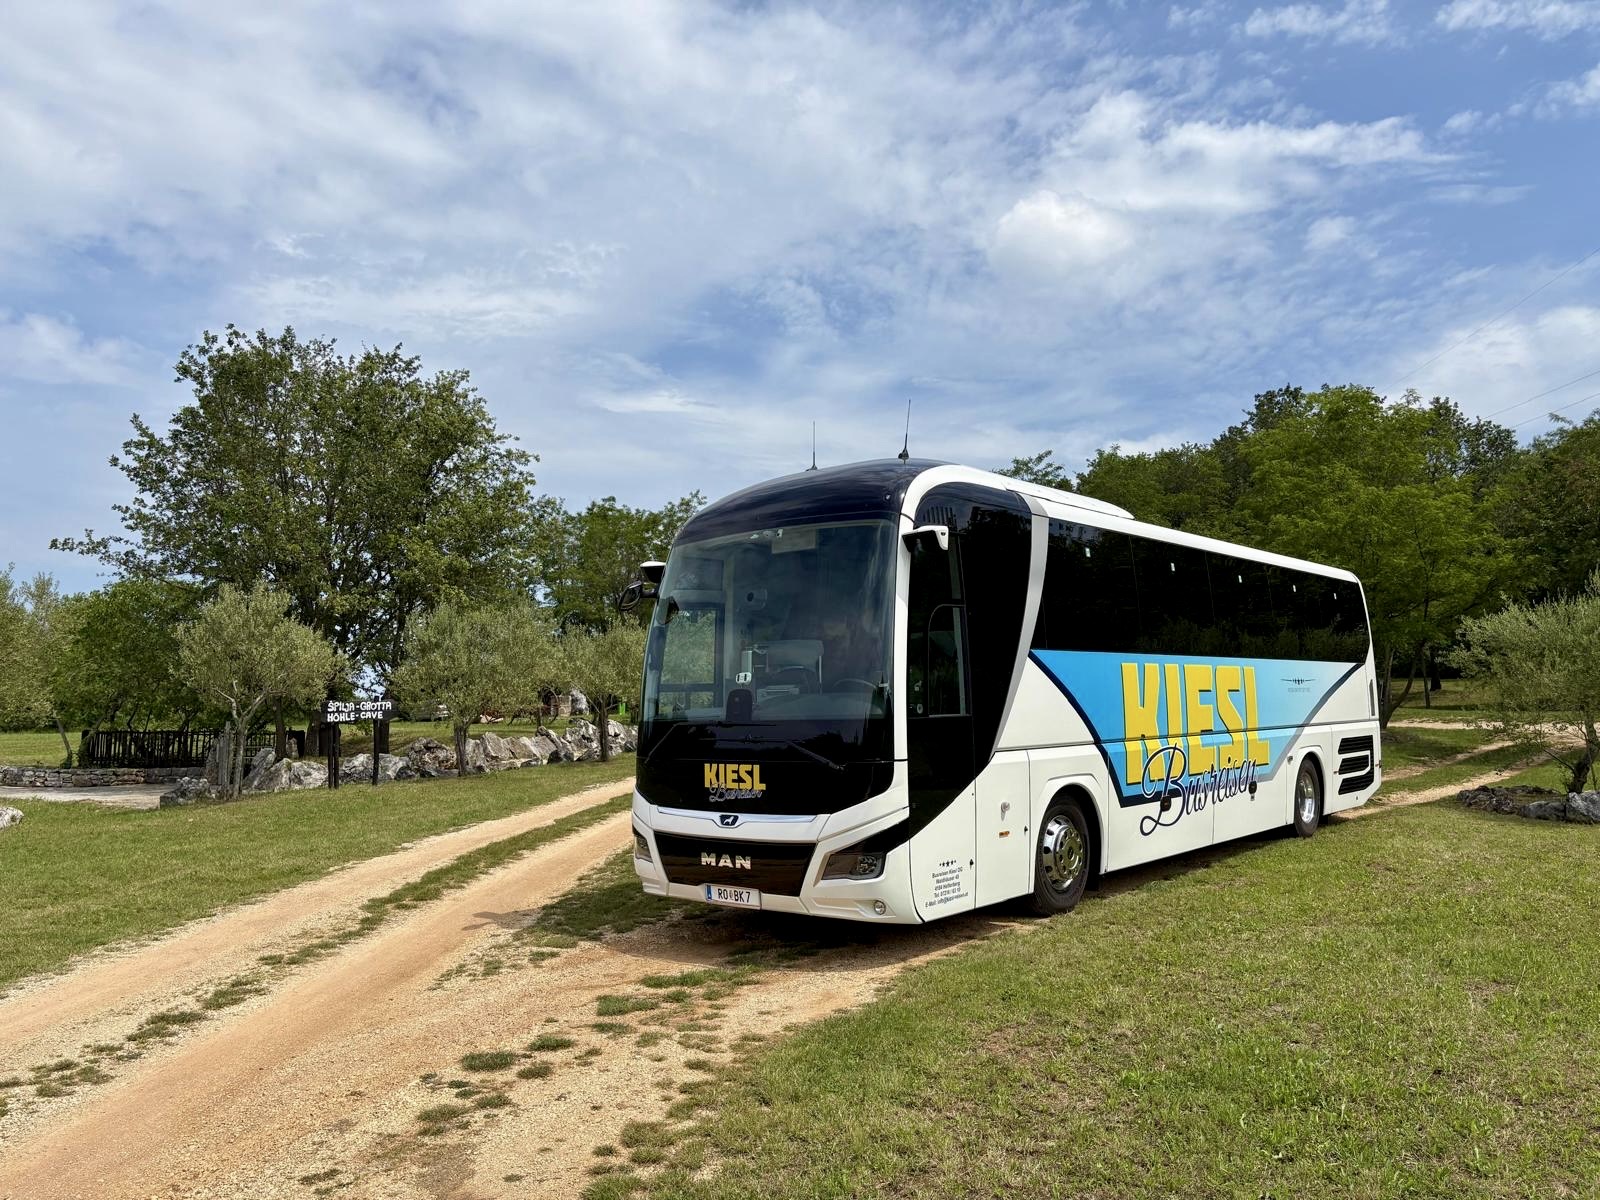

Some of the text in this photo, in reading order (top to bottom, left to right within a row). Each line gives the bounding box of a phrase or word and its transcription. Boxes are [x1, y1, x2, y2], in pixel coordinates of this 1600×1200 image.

[360, 702, 392, 710] GROTTA
[360, 711, 383, 719] CAVE
[1121, 662, 1270, 786] KIESL
[704, 763, 766, 790] KIESL
[1140, 743, 1257, 837] Busreisen
[701, 852, 751, 870] MAN
